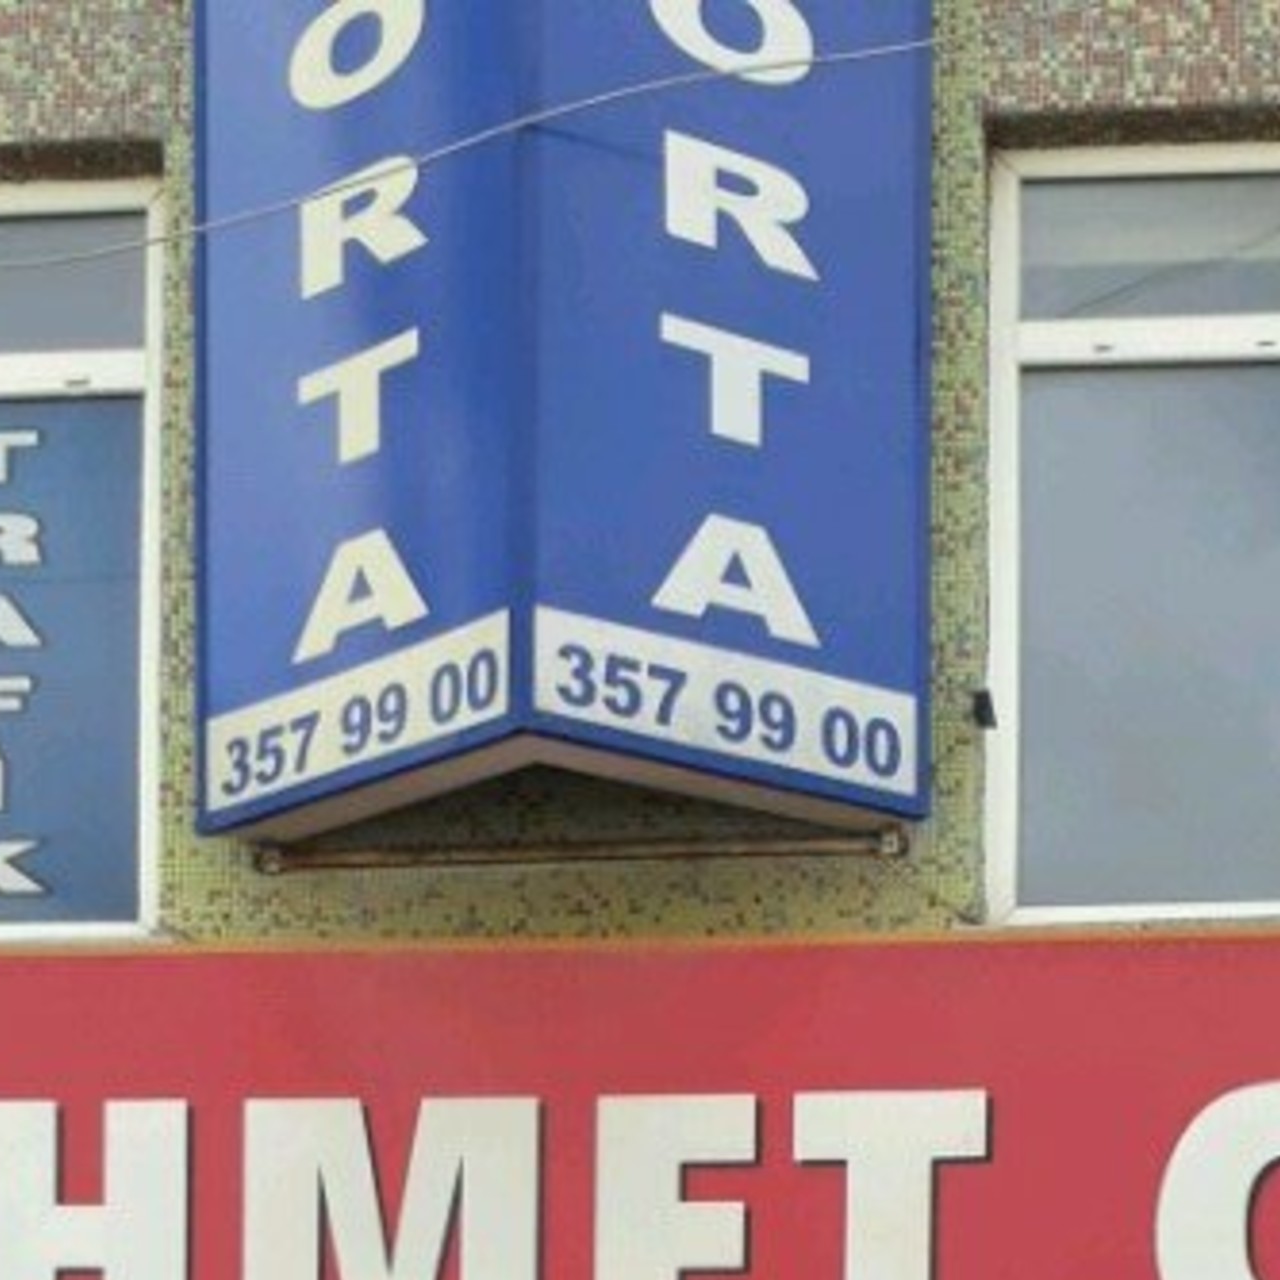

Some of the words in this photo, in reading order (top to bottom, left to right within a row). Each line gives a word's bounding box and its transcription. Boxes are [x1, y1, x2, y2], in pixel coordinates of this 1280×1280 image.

[221, 710, 319, 797] 357
[339, 682, 408, 754] 99
[429, 649, 499, 727] 00
[555, 644, 688, 727] 357
[713, 682, 797, 753] 99
[821, 707, 902, 778] 00
